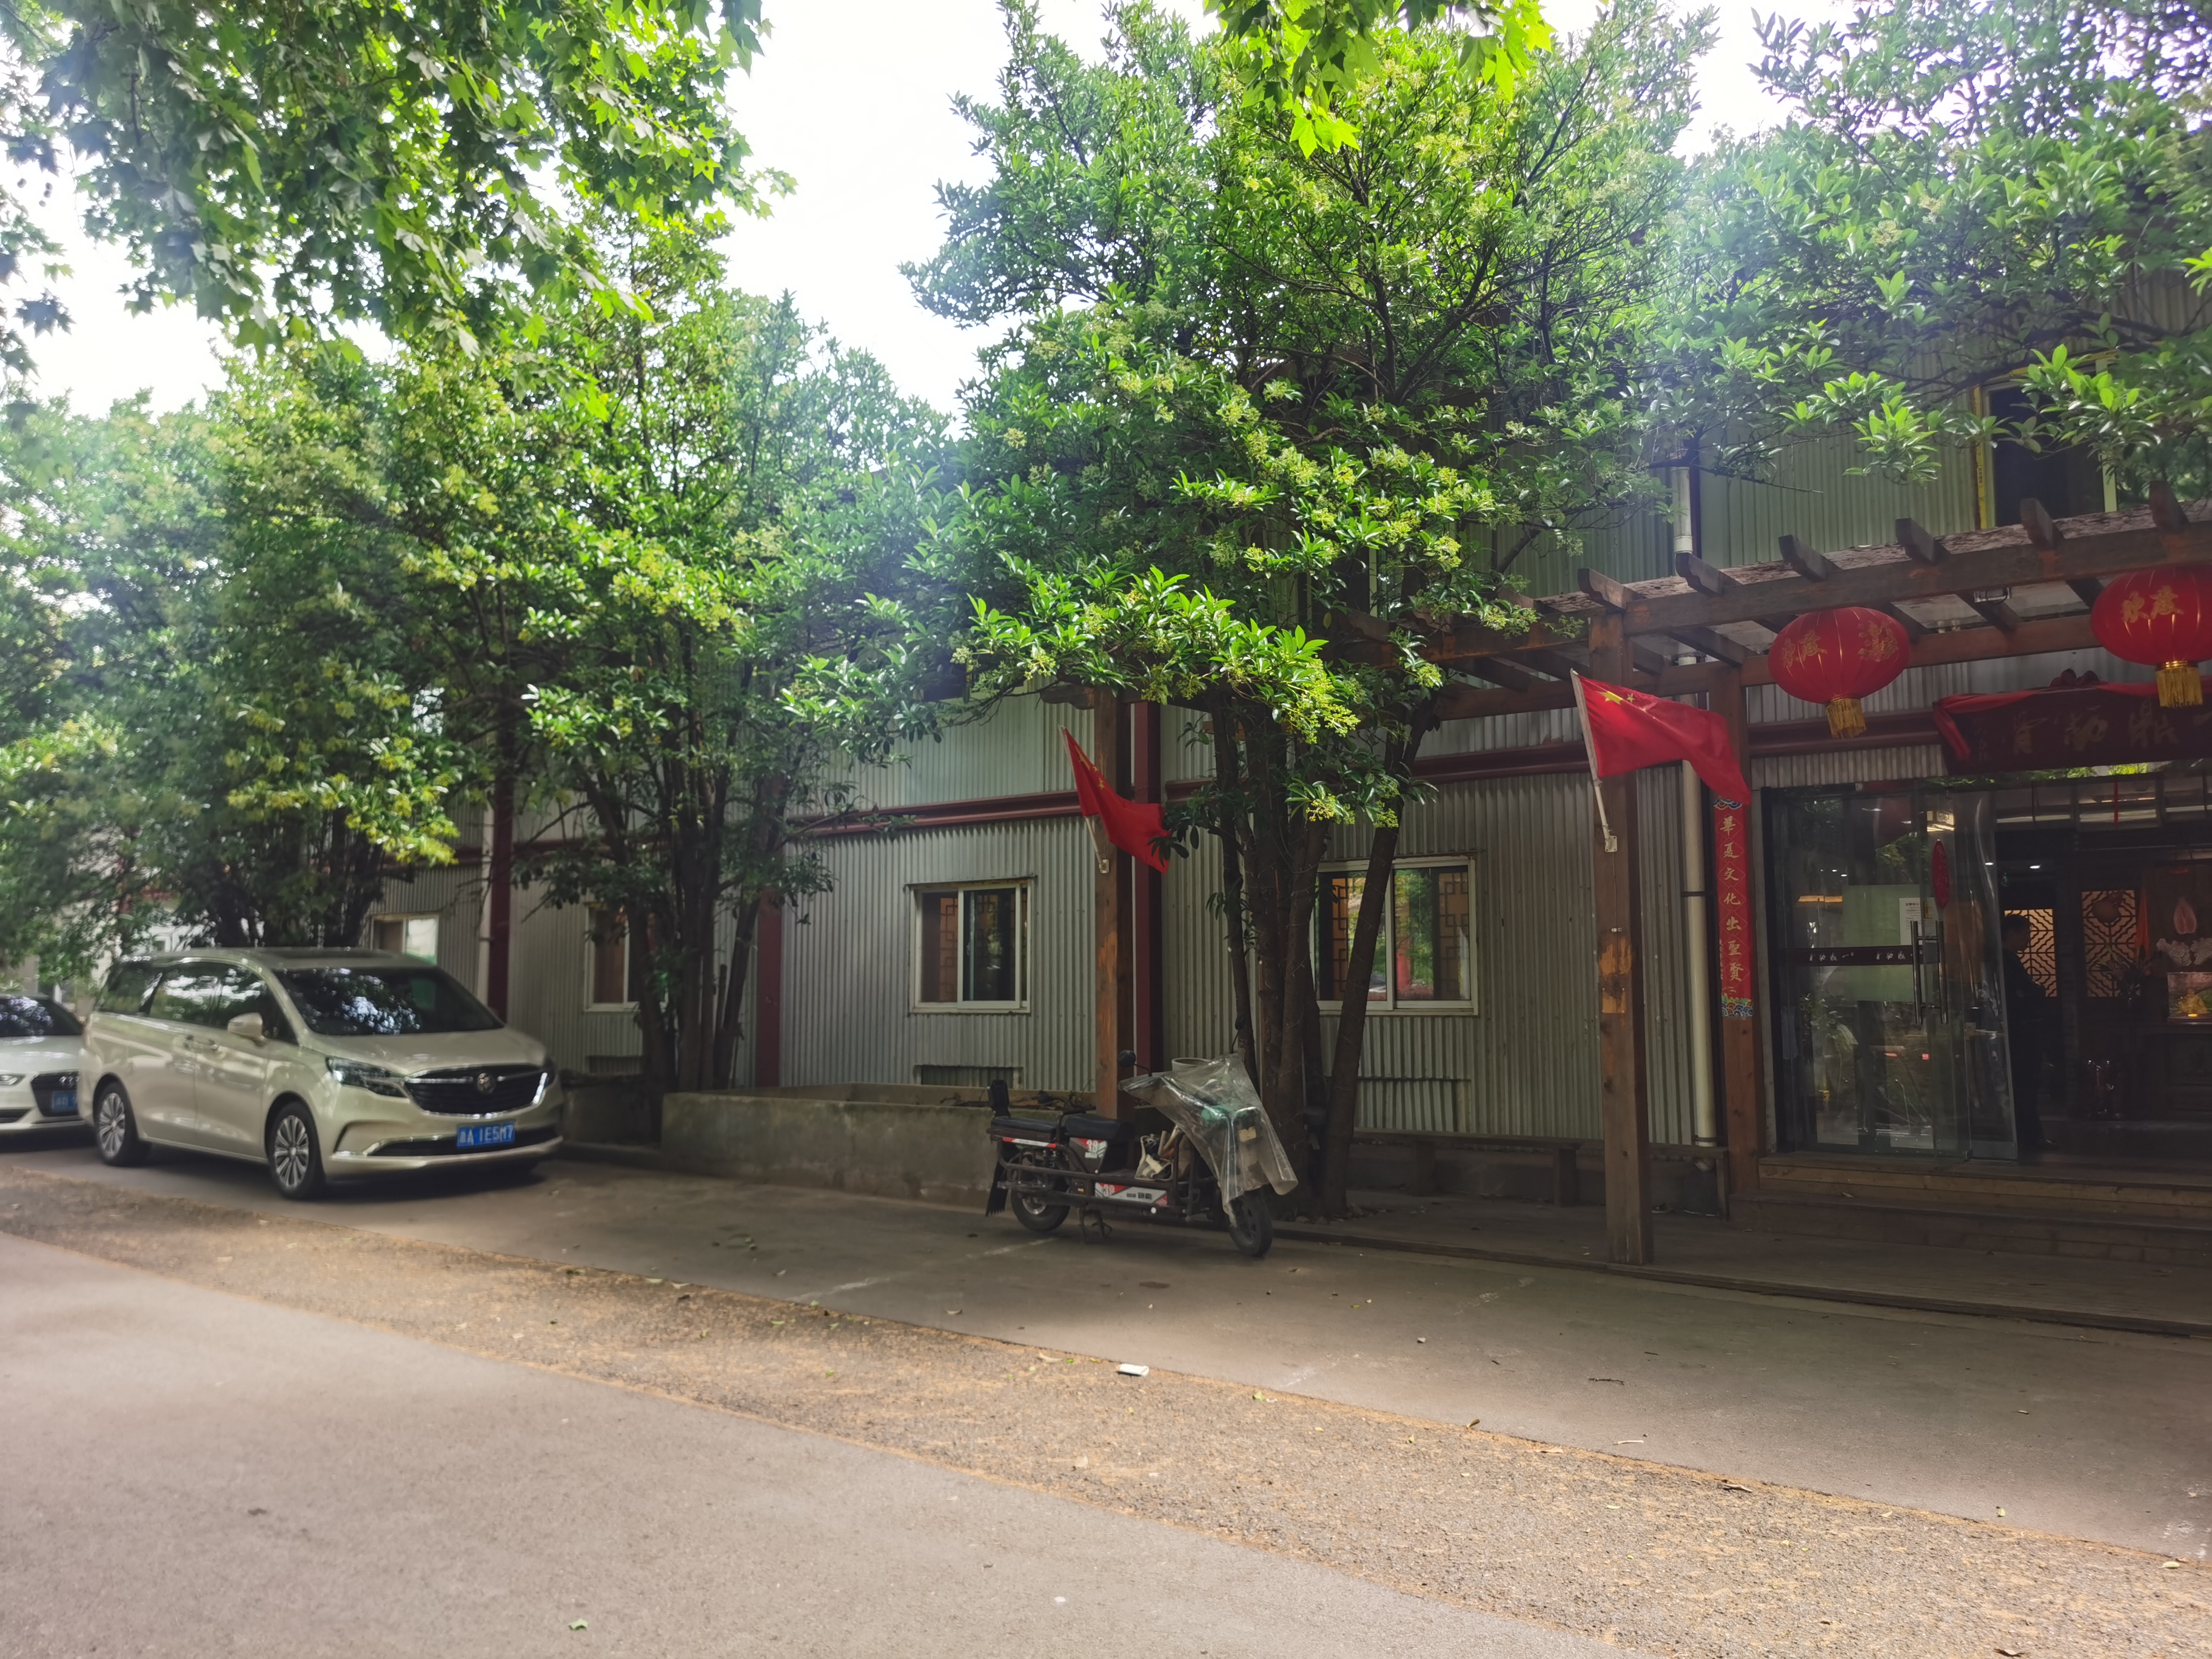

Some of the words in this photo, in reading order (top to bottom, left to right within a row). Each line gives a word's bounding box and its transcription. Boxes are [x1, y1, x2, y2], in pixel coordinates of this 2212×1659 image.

[1719, 815, 1744, 982] 華夏文化出聖賢
